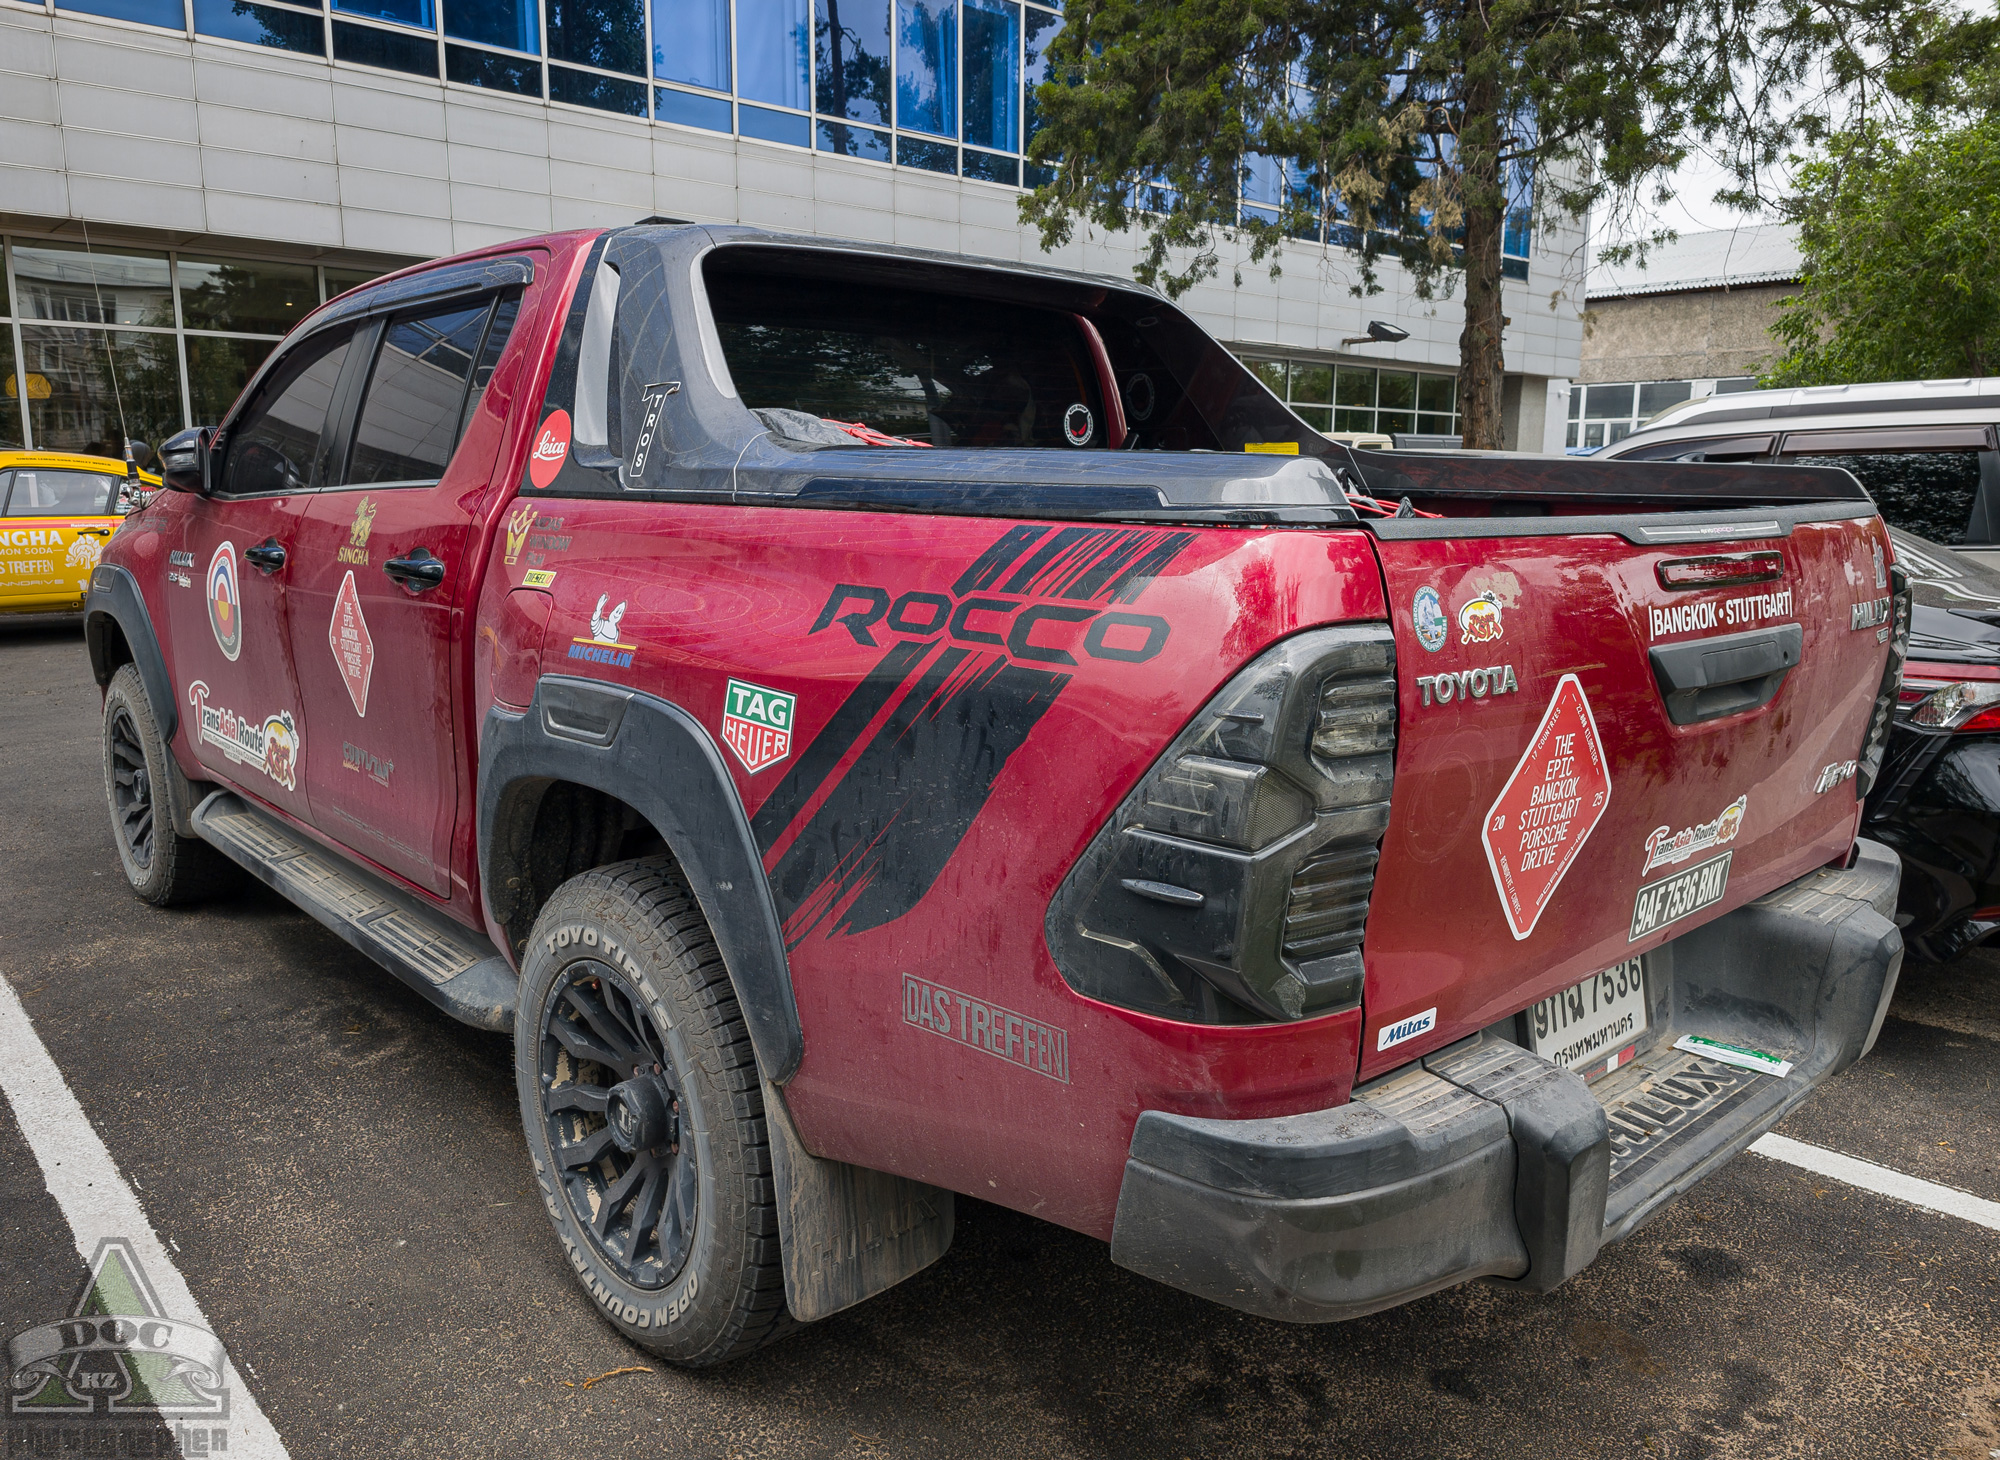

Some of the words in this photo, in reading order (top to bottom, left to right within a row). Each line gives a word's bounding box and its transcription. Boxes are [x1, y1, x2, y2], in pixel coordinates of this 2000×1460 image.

[533, 430, 566, 461] Leica
[24, 547, 53, 555] SODA
[337, 546, 369, 566] SINGHA
[529, 535, 573, 552] WINDOW
[7, 559, 54, 574] TREFFEN
[343, 601, 352, 615] THE
[1654, 601, 1717, 636] BANGKOK
[1726, 591, 1790, 625] STUTTGART
[808, 583, 1172, 667] ROCCO
[1463, 620, 1502, 642] ASIA
[567, 644, 633, 669] MICHELIN
[1416, 664, 1519, 708] TOYOTA
[732, 686, 788, 726] TAG
[239, 719, 264, 755] Route
[725, 719, 786, 767] HEUER
[1537, 707, 1561, 751] COUNTRIES
[1554, 733, 1576, 757] THE
[1584, 726, 1598, 766] KILOMETERS
[1545, 756, 1575, 782] EPIC
[1530, 776, 1581, 807] BANGKOK
[1592, 790, 1604, 808] 25
[1492, 814, 1505, 832] 20
[1518, 797, 1582, 831] STUTTGART
[1519, 820, 1570, 852] PORSCHE
[1693, 823, 1717, 843] Route
[1521, 844, 1558, 873] DRIVE
[1511, 892, 1522, 915] CURVES
[1635, 885, 1666, 935] 9AF
[1662, 871, 1699, 922] 7536
[1697, 859, 1728, 907] BKK
[546, 926, 598, 955] TOYO
[602, 935, 673, 1031] TIRES
[907, 979, 951, 1034] DAS
[956, 996, 1063, 1078] TREFFEN
[1383, 1016, 1431, 1045] Mitas
[560, 1234, 650, 1328] COUNTRY
[654, 1269, 699, 1329] OPEN
